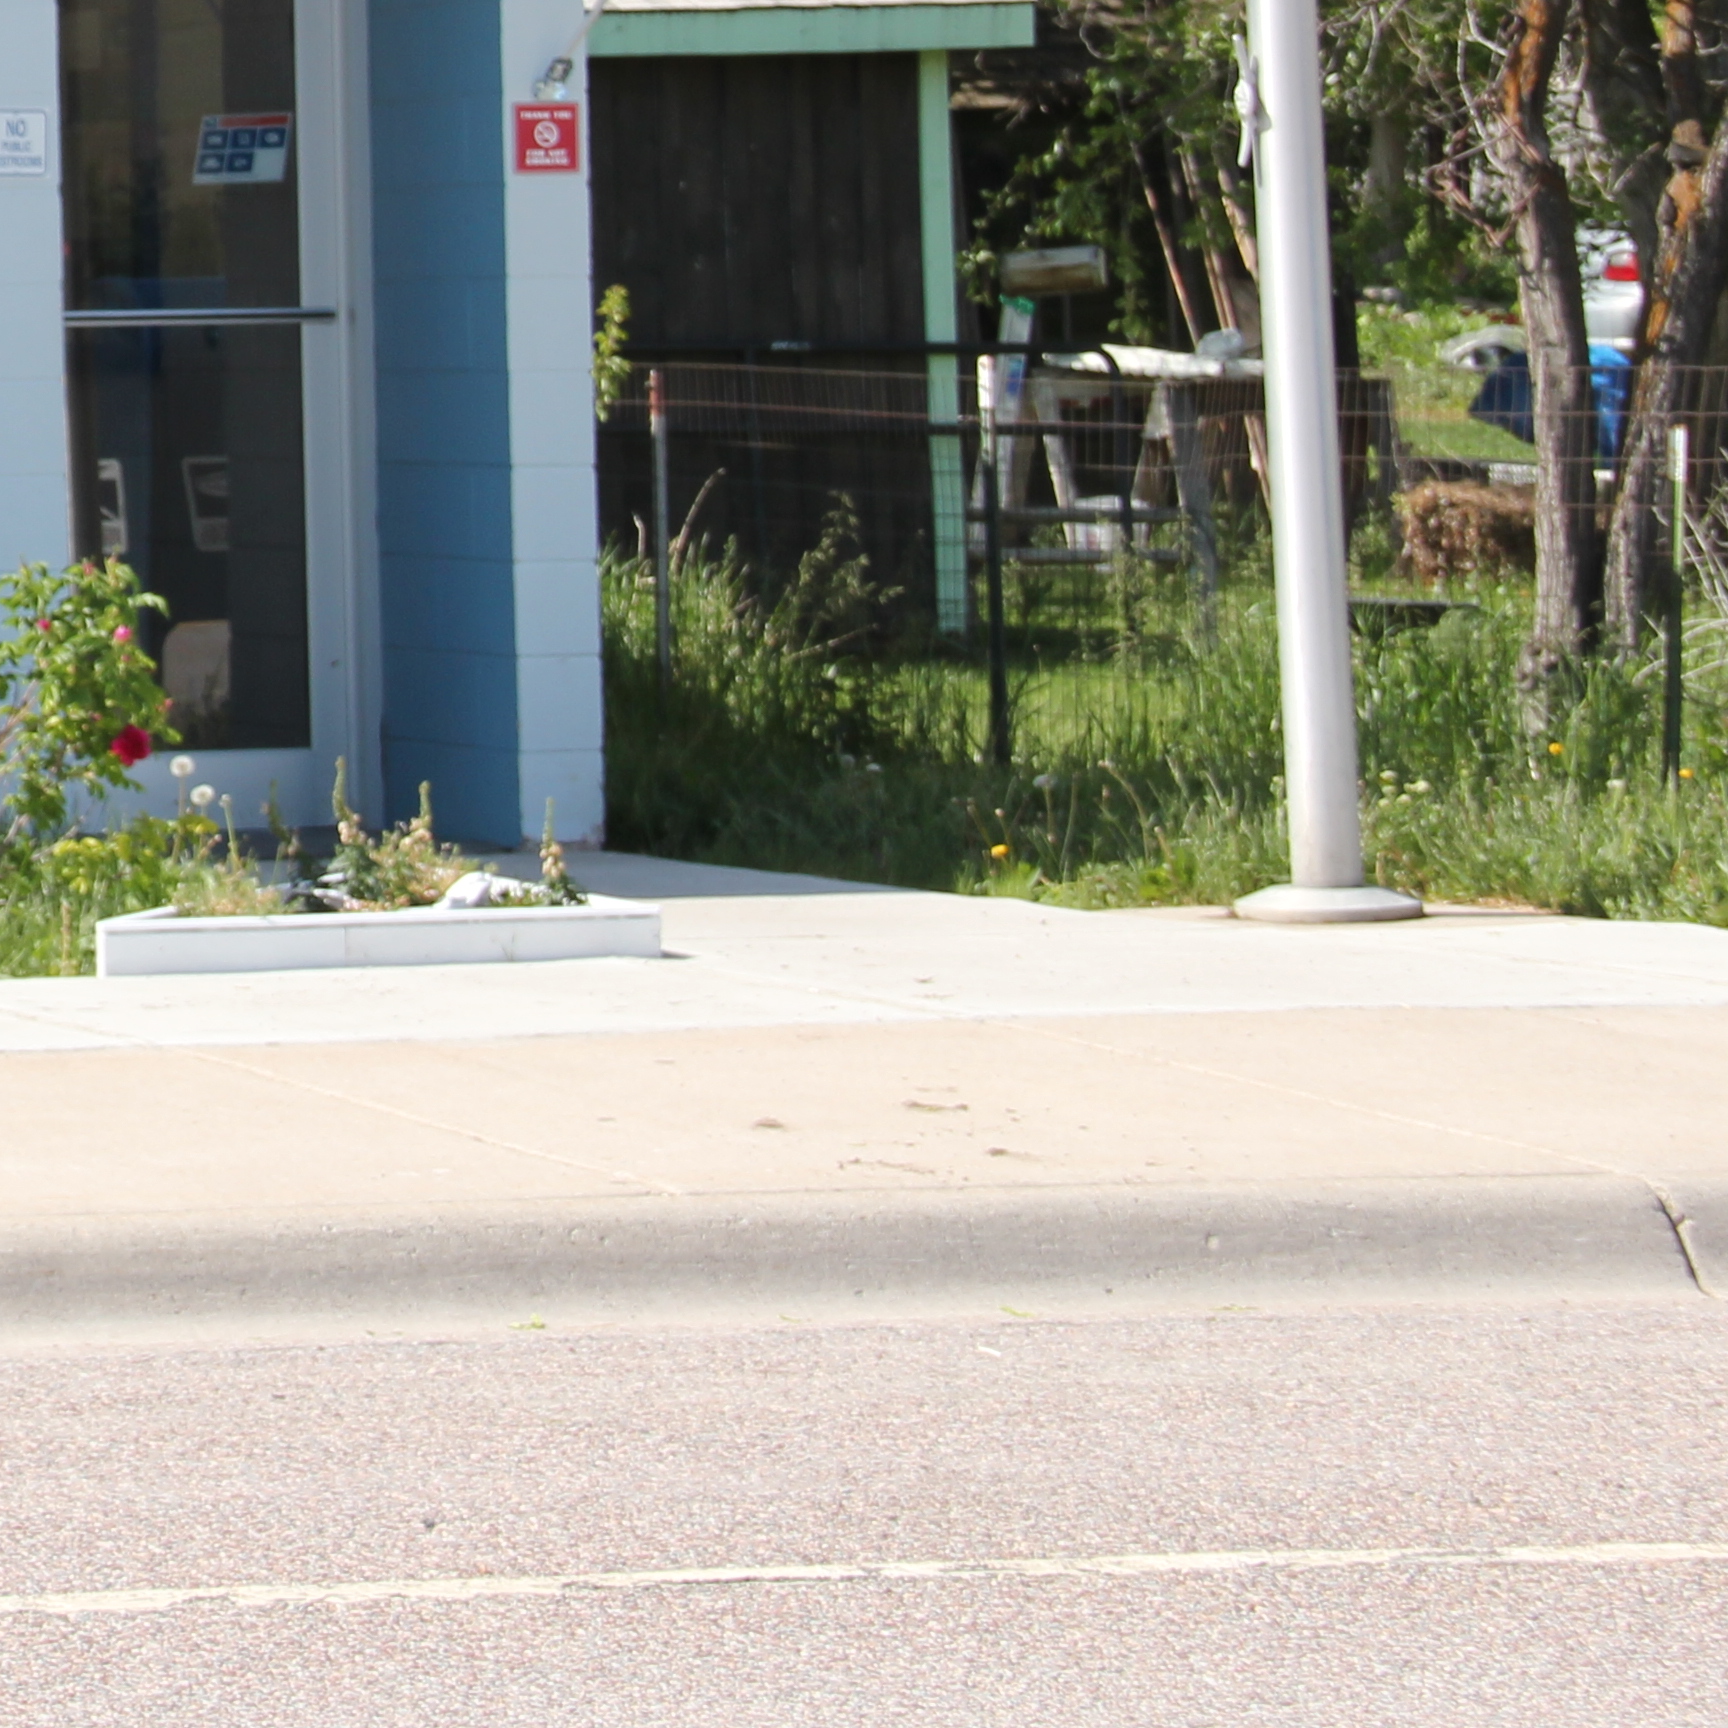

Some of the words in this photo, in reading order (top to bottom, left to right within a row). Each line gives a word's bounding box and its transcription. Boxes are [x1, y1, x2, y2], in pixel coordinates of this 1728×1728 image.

[520, 110, 552, 120] THANK
[554, 110, 573, 120] YOU
[5, 118, 26, 138] NO
[0, 140, 32, 152] PUBLIC
